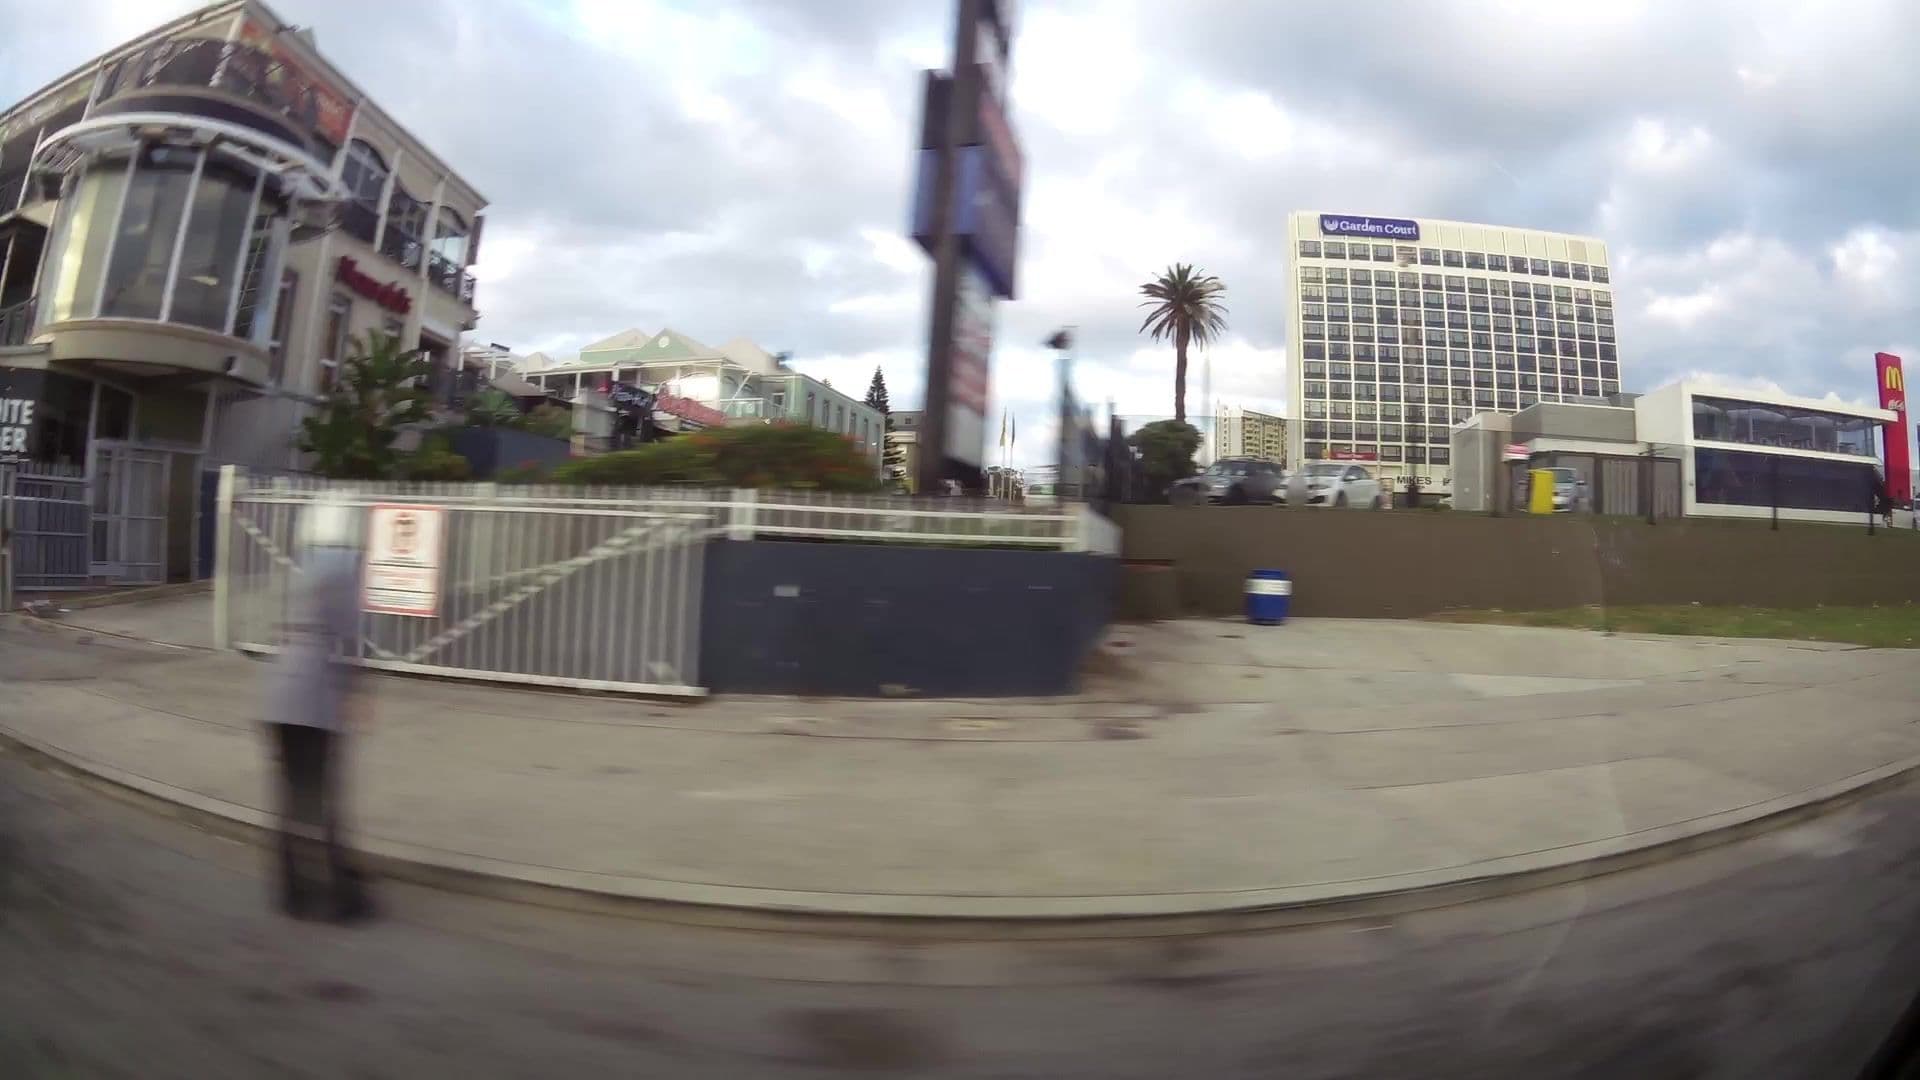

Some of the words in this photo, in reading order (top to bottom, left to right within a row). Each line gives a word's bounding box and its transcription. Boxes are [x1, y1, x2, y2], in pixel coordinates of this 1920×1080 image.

[1340, 218, 1383, 233] Garden
[1384, 224, 1417, 235] Court
[0, 398, 35, 424] ITE
[0, 427, 27, 452] ER
[1397, 475, 1432, 485] MIKES
